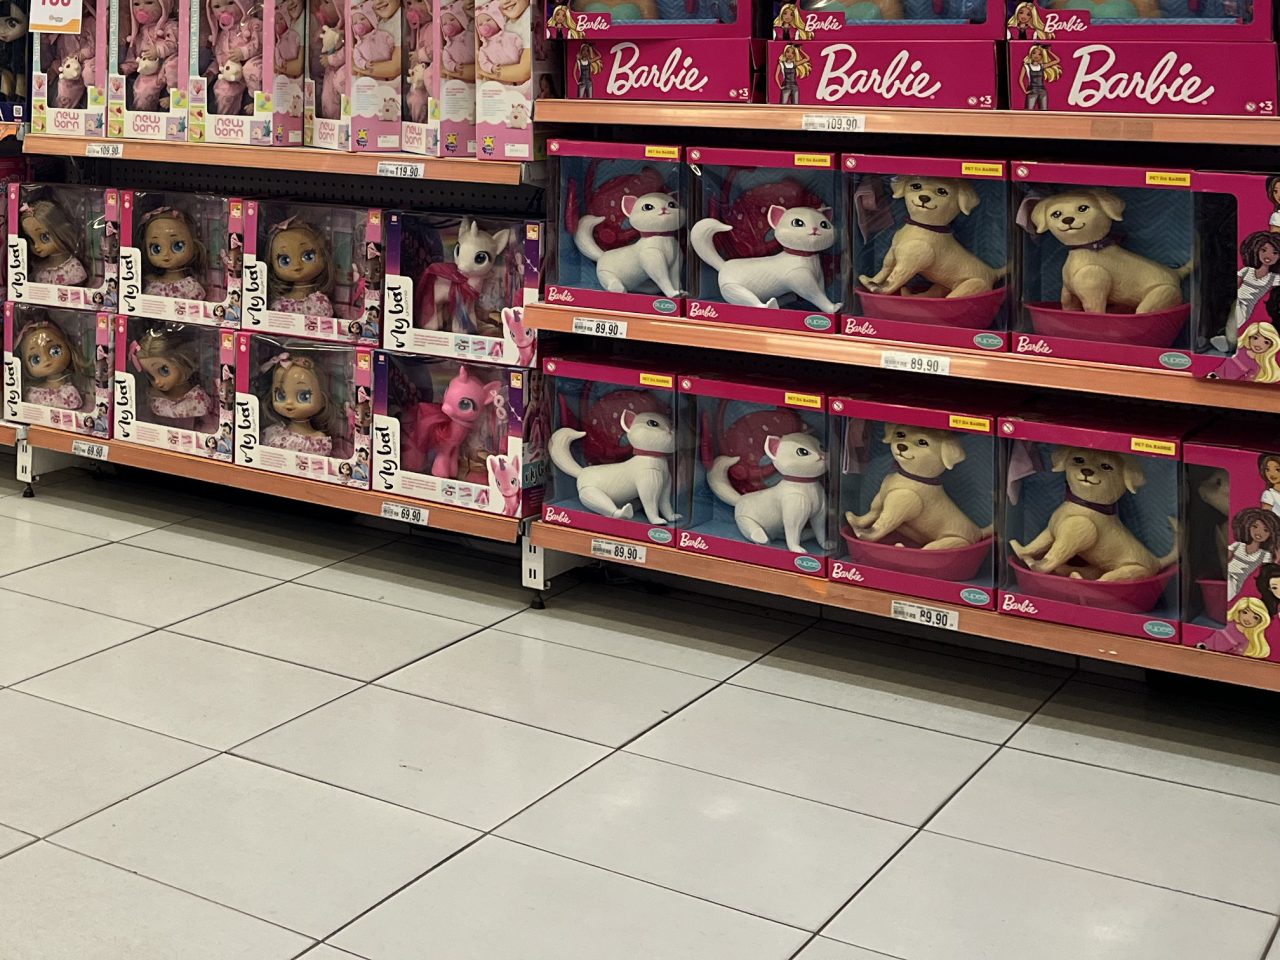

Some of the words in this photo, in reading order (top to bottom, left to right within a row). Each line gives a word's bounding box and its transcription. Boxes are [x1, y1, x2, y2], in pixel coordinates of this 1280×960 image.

[576, 14, 610, 32] Barbie
[805, 14, 842, 31] Barbie
[1045, 13, 1087, 33] Barbie
[607, 42, 708, 96] Barbie
[816, 44, 941, 102] Barbie
[1068, 44, 1215, 107] Barbie
[214, 125, 243, 137] born
[217, 118, 243, 128] new
[548, 287, 574, 303] Barbie
[690, 302, 718, 318] Barbie
[845, 318, 876, 336] Barbie
[1017, 336, 1053, 354] Barbie
[545, 508, 571, 524] Barbie
[680, 533, 709, 551] Barbie
[832, 563, 864, 582] Barbie
[1003, 595, 1038, 614] Barbie
